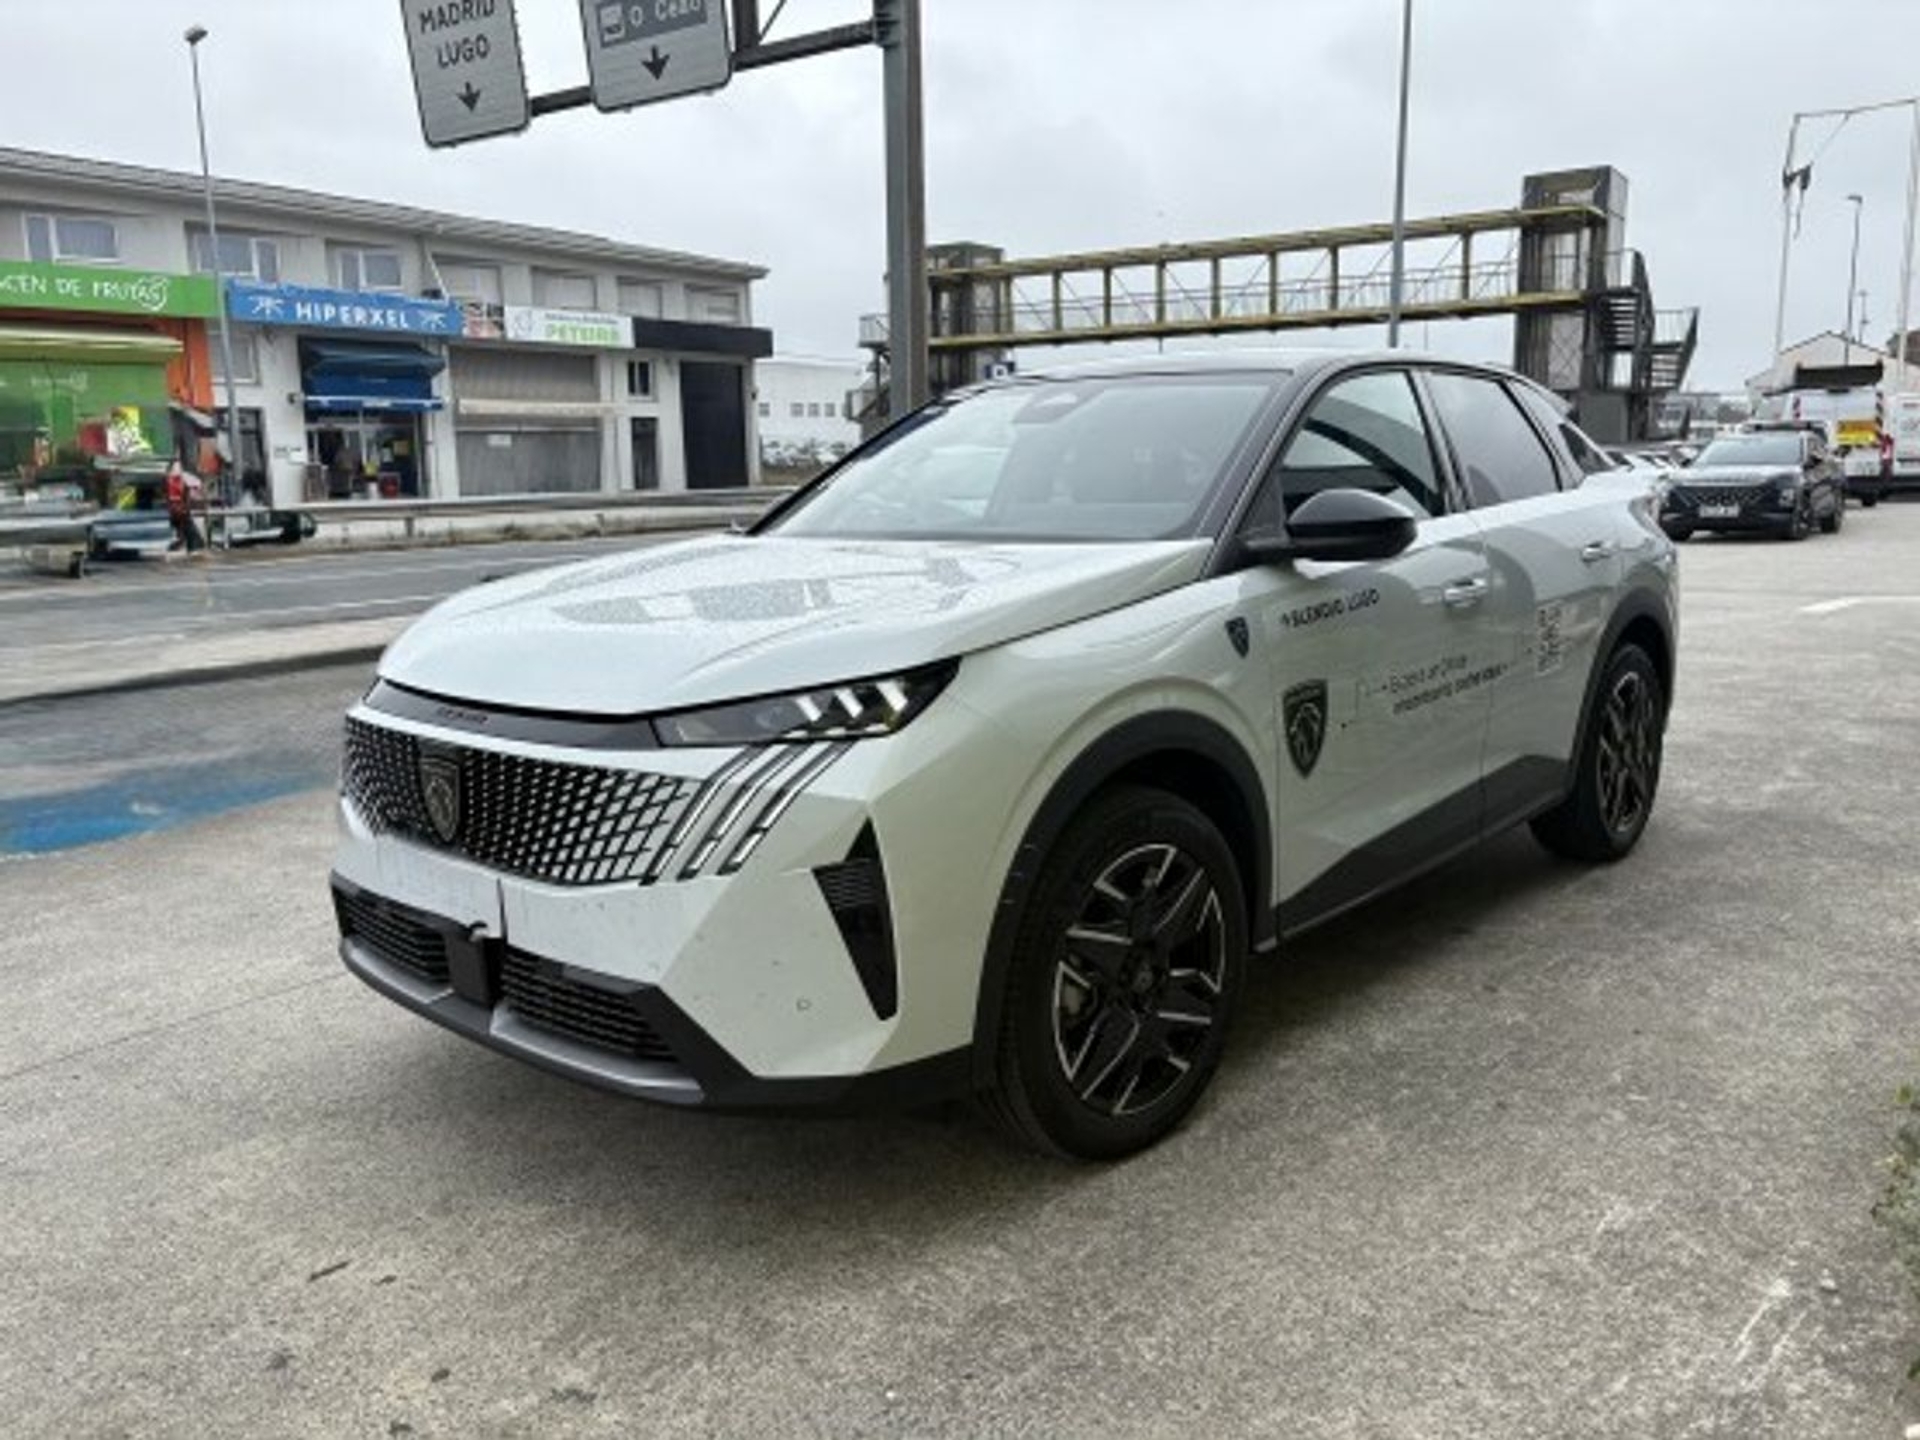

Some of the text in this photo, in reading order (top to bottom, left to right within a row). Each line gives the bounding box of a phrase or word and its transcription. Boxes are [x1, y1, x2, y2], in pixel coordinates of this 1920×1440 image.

[436, 33, 491, 68] LUGO
[55, 278, 82, 297] DE
[296, 301, 409, 328] HIPERXEL
